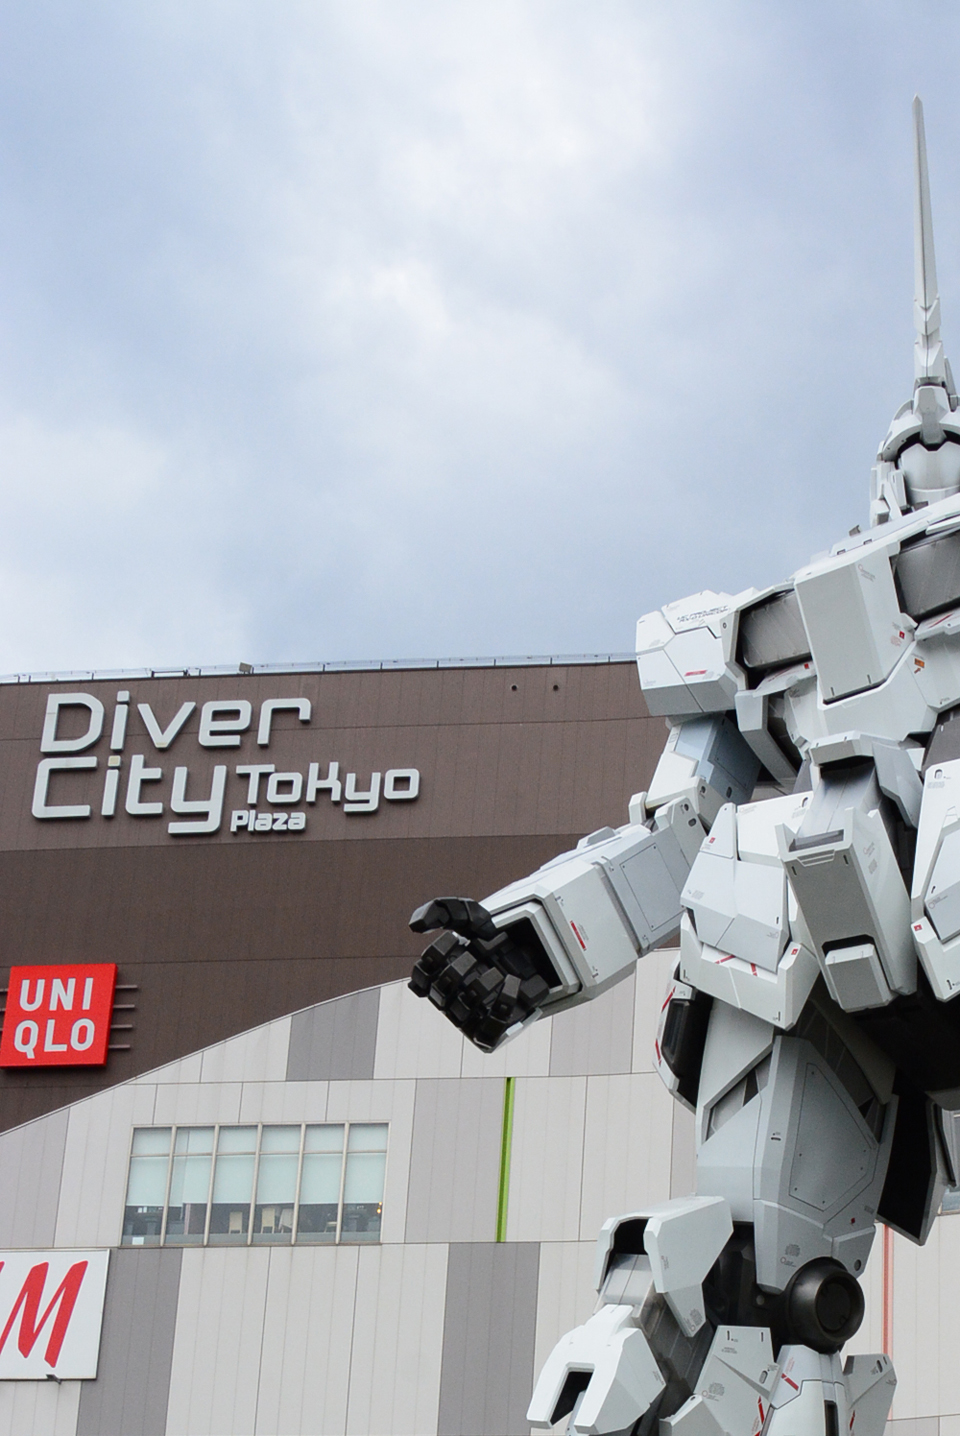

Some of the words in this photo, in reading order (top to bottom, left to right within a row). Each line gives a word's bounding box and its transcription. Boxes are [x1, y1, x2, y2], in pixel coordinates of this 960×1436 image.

[40, 690, 313, 754] Diver
[31, 754, 228, 835] City
[229, 808, 307, 833] Plaza
[18, 977, 95, 1012] UNI
[13, 1018, 96, 1059] QLO
[0, 1260, 89, 1368] M
